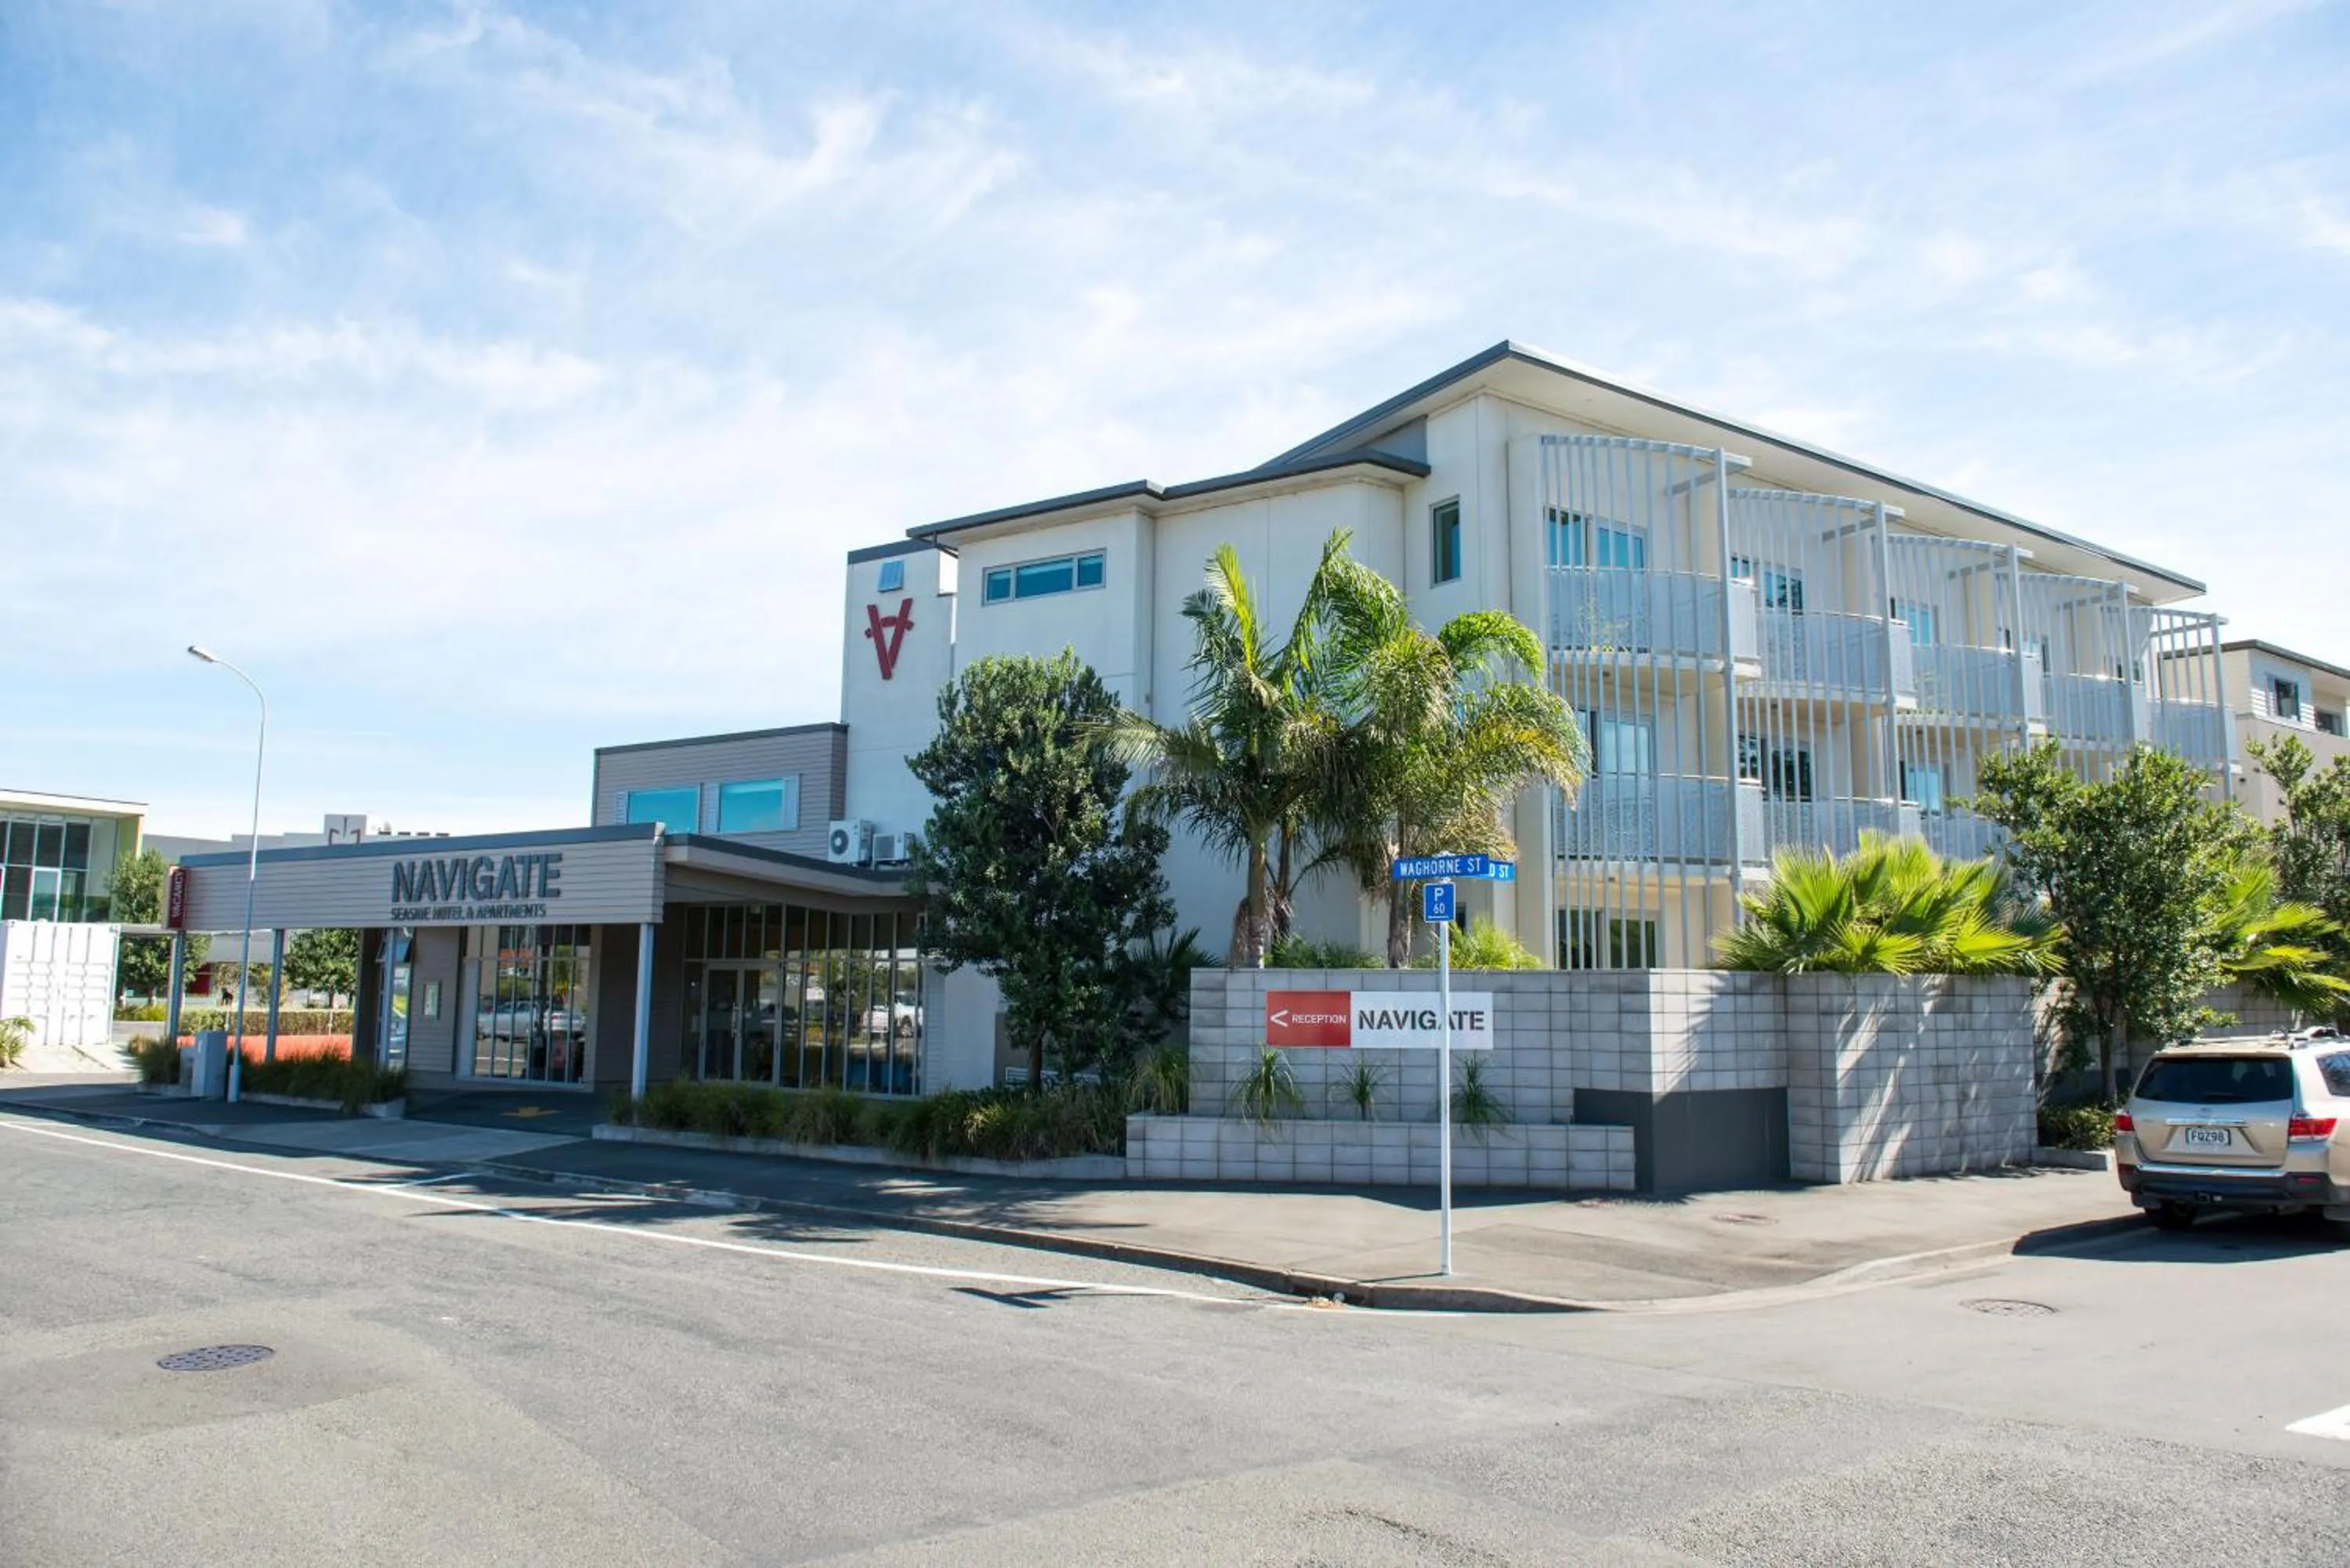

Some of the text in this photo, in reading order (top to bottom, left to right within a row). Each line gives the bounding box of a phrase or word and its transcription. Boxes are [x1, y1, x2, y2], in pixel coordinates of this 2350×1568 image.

[1400, 858, 1481, 876] WAGHORNE ST
[1499, 865, 1509, 878] ST
[392, 853, 562, 901] NAVIGATE
[172, 870, 183, 917] VACANCY
[1434, 887, 1444, 901] P
[391, 906, 429, 921] SEASIDE
[432, 905, 464, 920] HOTEL
[476, 903, 546, 919] APARTMENTS
[1433, 903, 1445, 914] 60
[1292, 1014, 1347, 1023] RECEPTION
